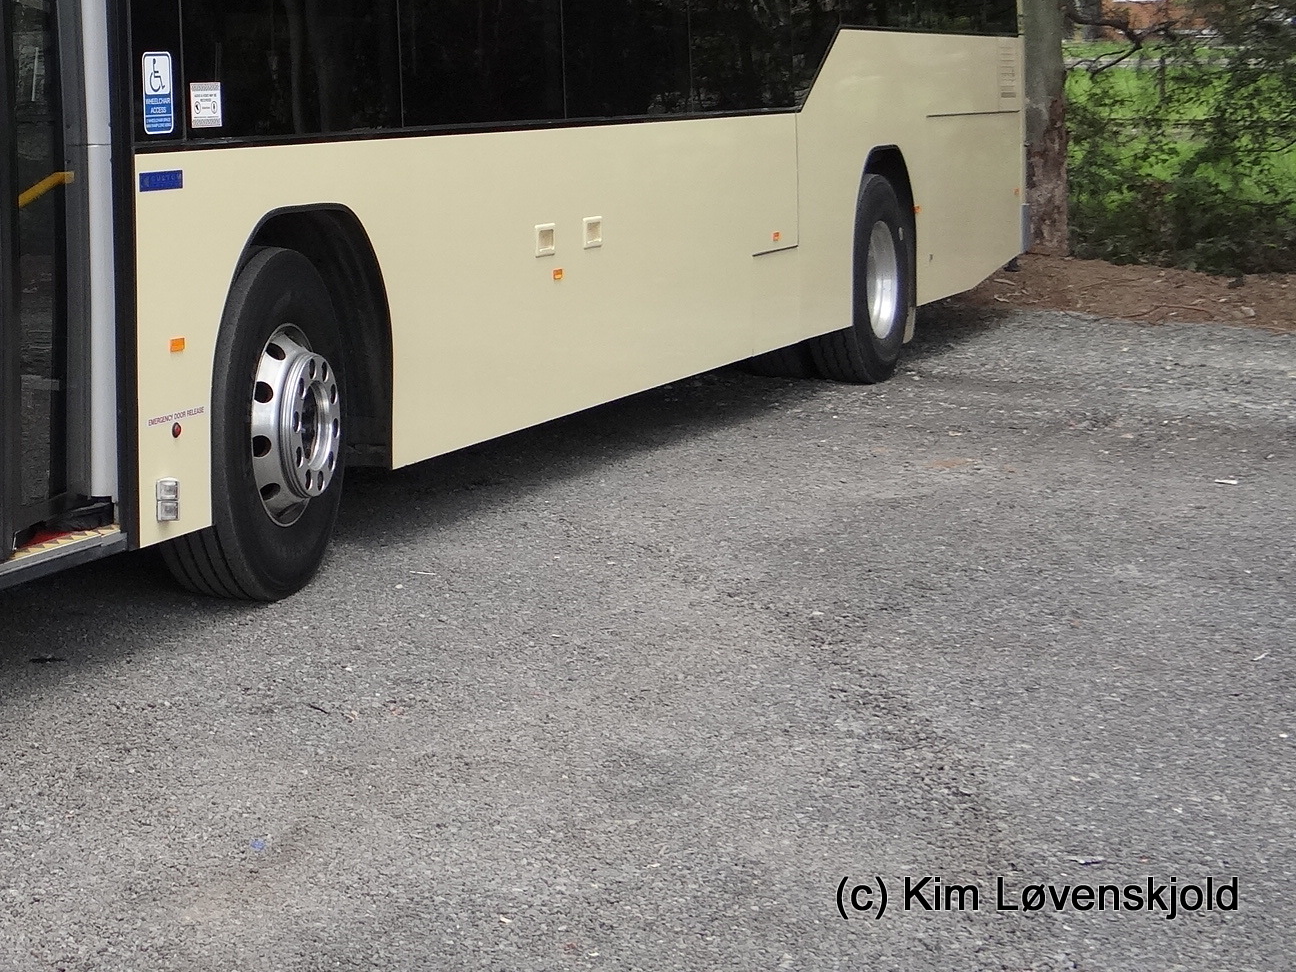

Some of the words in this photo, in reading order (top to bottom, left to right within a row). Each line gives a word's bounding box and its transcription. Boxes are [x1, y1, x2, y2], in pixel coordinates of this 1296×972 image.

[145, 97, 171, 105] WHEELCHAIR
[150, 106, 167, 114] ACCESS
[148, 414, 173, 426] EMERGENCY
[174, 411, 186, 419] DOOR
[187, 406, 204, 416] RELEASE
